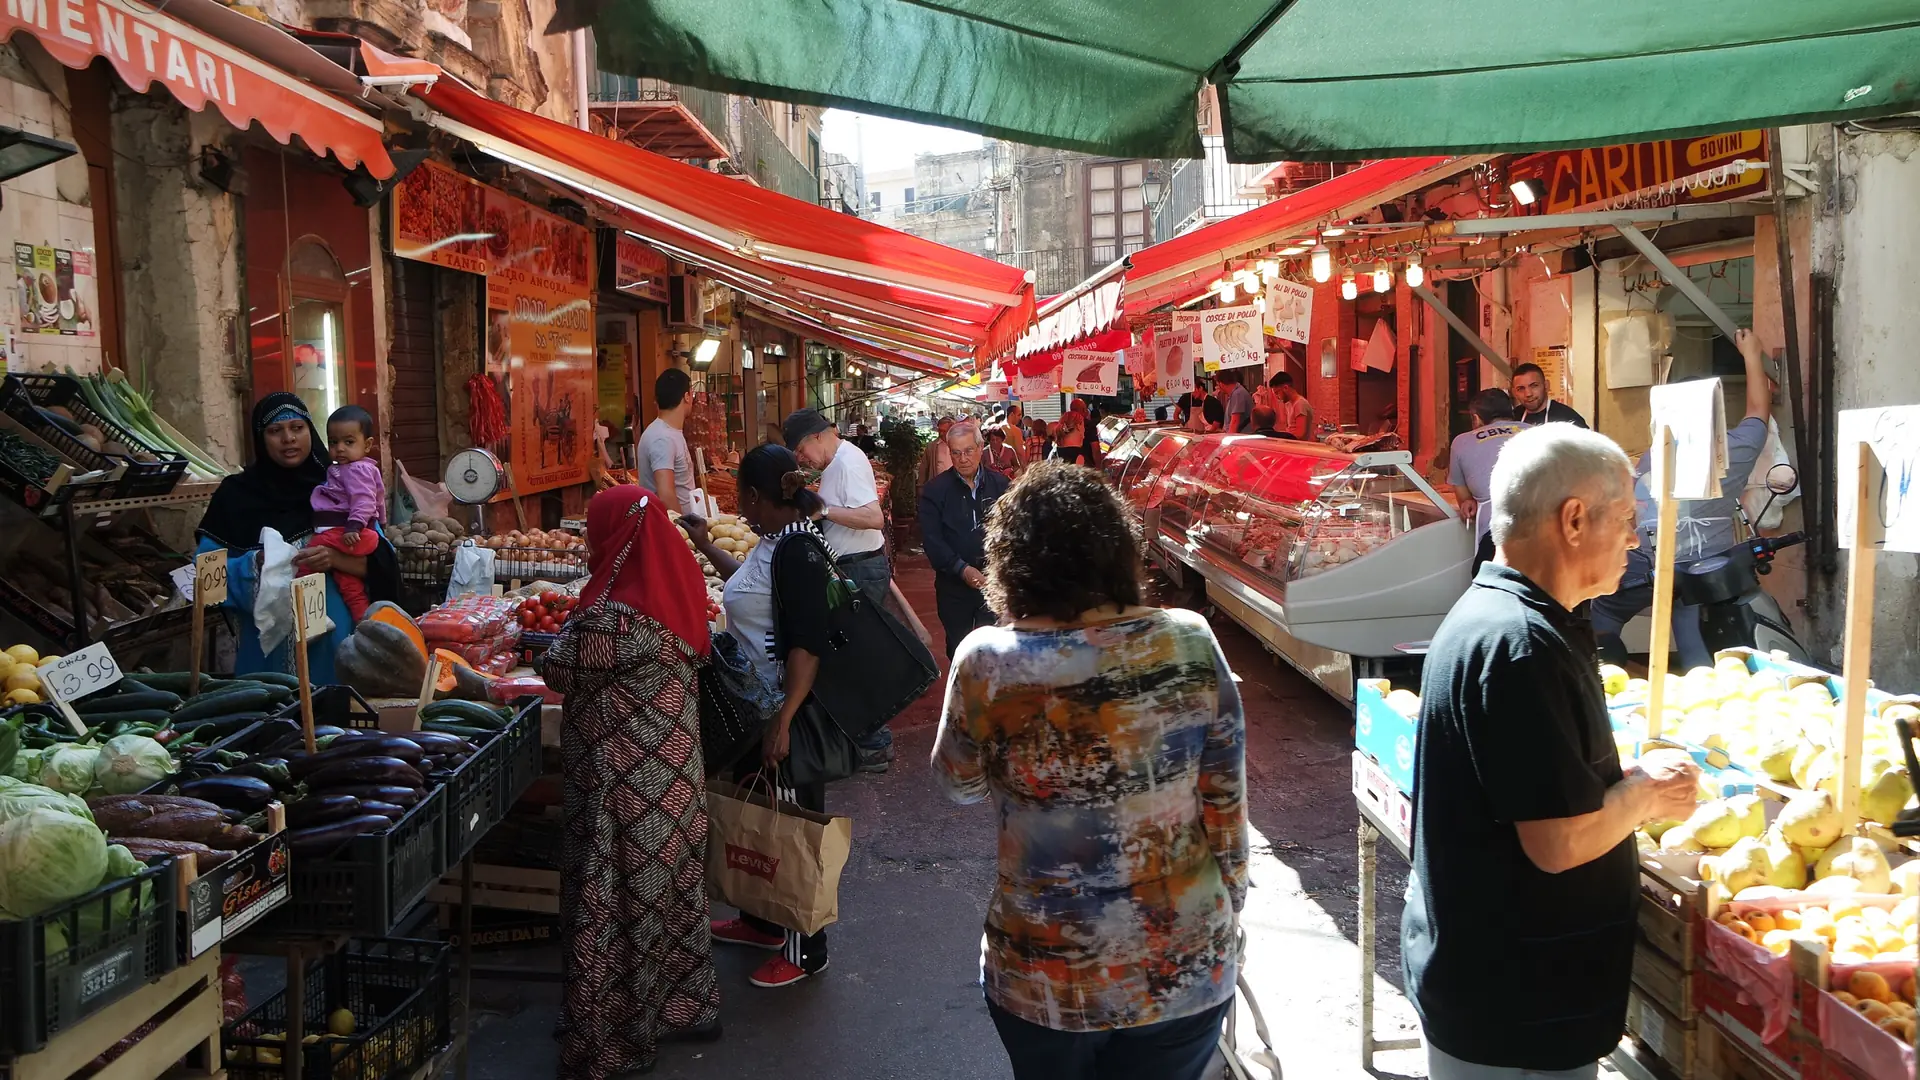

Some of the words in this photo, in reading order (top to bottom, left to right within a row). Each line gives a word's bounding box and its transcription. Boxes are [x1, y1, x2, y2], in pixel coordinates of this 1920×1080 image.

[1700, 131, 1742, 160] BOVINI
[431, 251, 438, 262] E
[447, 255, 486, 273] TANTO
[492, 264, 525, 283] ALTRO
[1273, 283, 1283, 291] ALI
[1291, 288, 1307, 299] POLLO
[515, 294, 547, 324] ODORI
[555, 303, 589, 332] SAPORI
[1205, 312, 1225, 323] COSCE
[1227, 312, 1235, 320] DI
[1237, 309, 1257, 319] POLLO
[1177, 334, 1189, 343] POLLO
[1096, 355, 1115, 363] MAIALE
[1247, 350, 1261, 361] kg.
[1100, 384, 1113, 393] kg.
